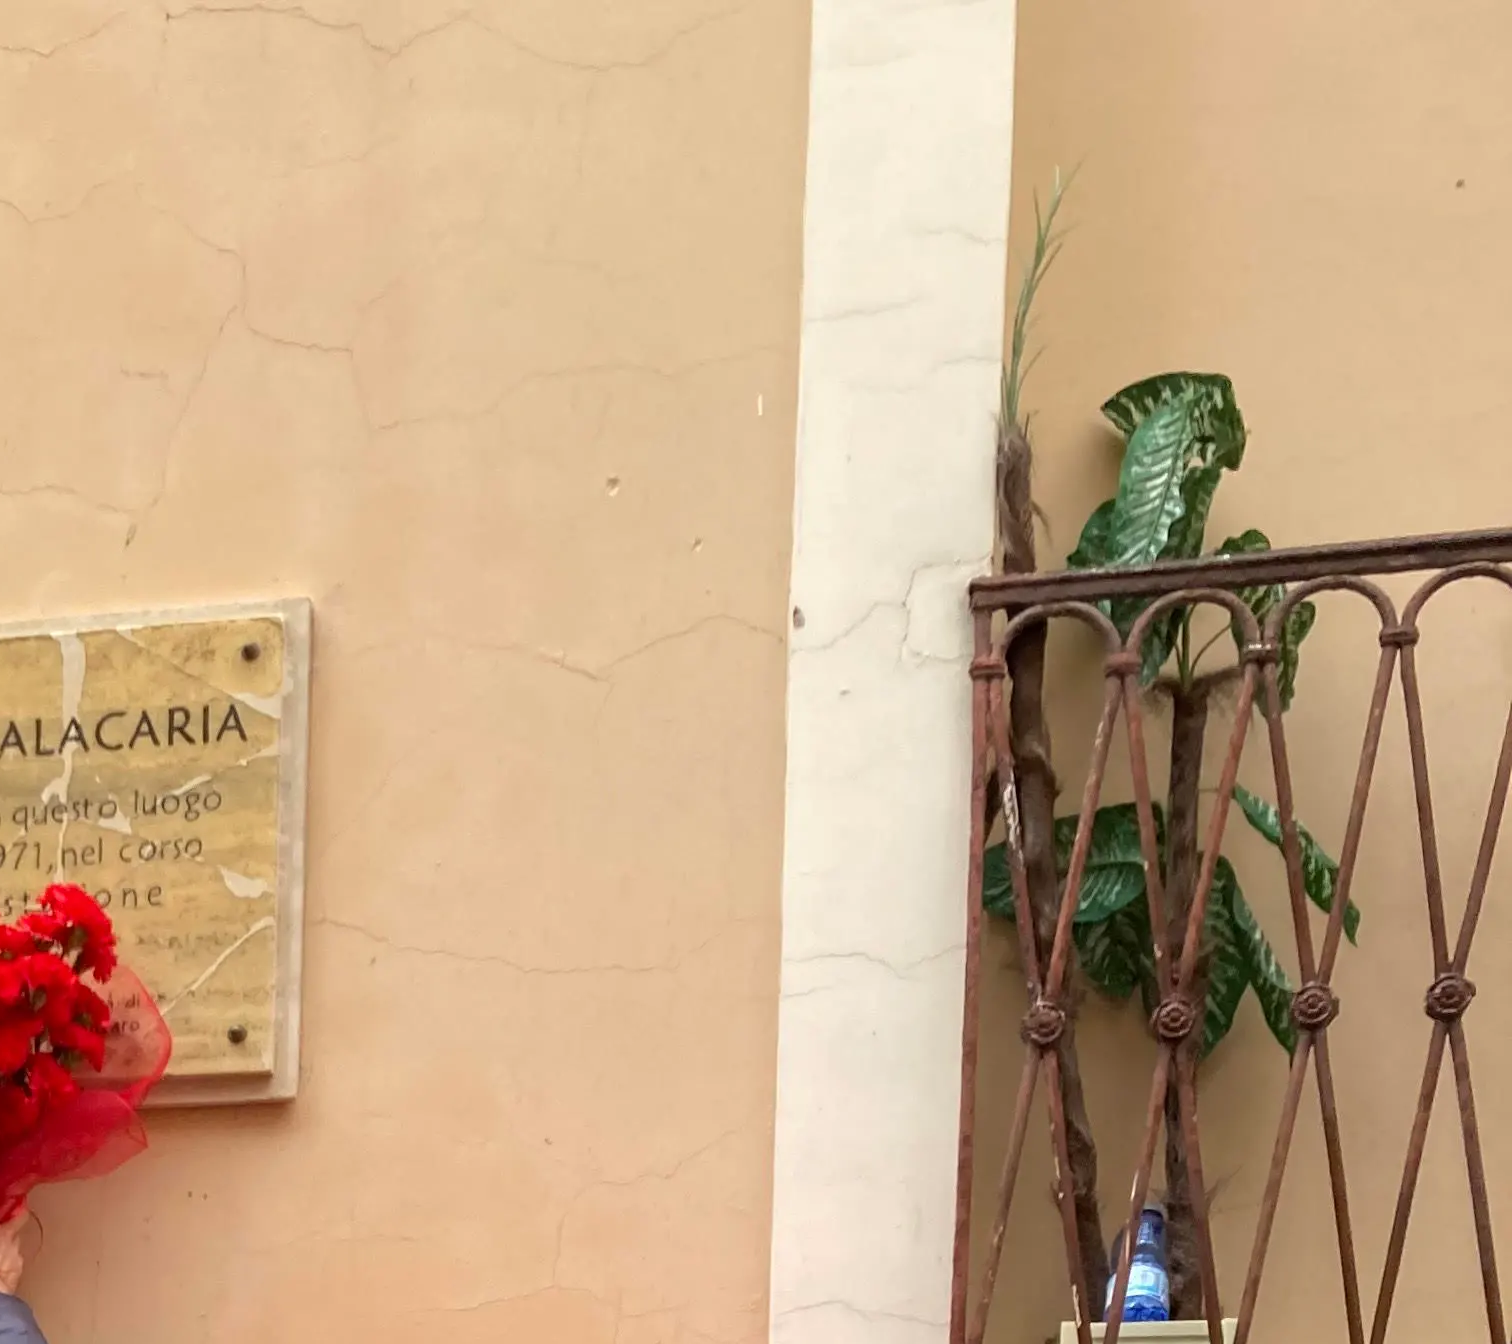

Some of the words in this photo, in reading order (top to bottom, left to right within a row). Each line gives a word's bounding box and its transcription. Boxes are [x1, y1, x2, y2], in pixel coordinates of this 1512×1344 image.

[11, 797, 118, 833] questo
[133, 788, 223, 823] luogo
[60, 837, 104, 867] nel
[118, 837, 204, 864] corso
